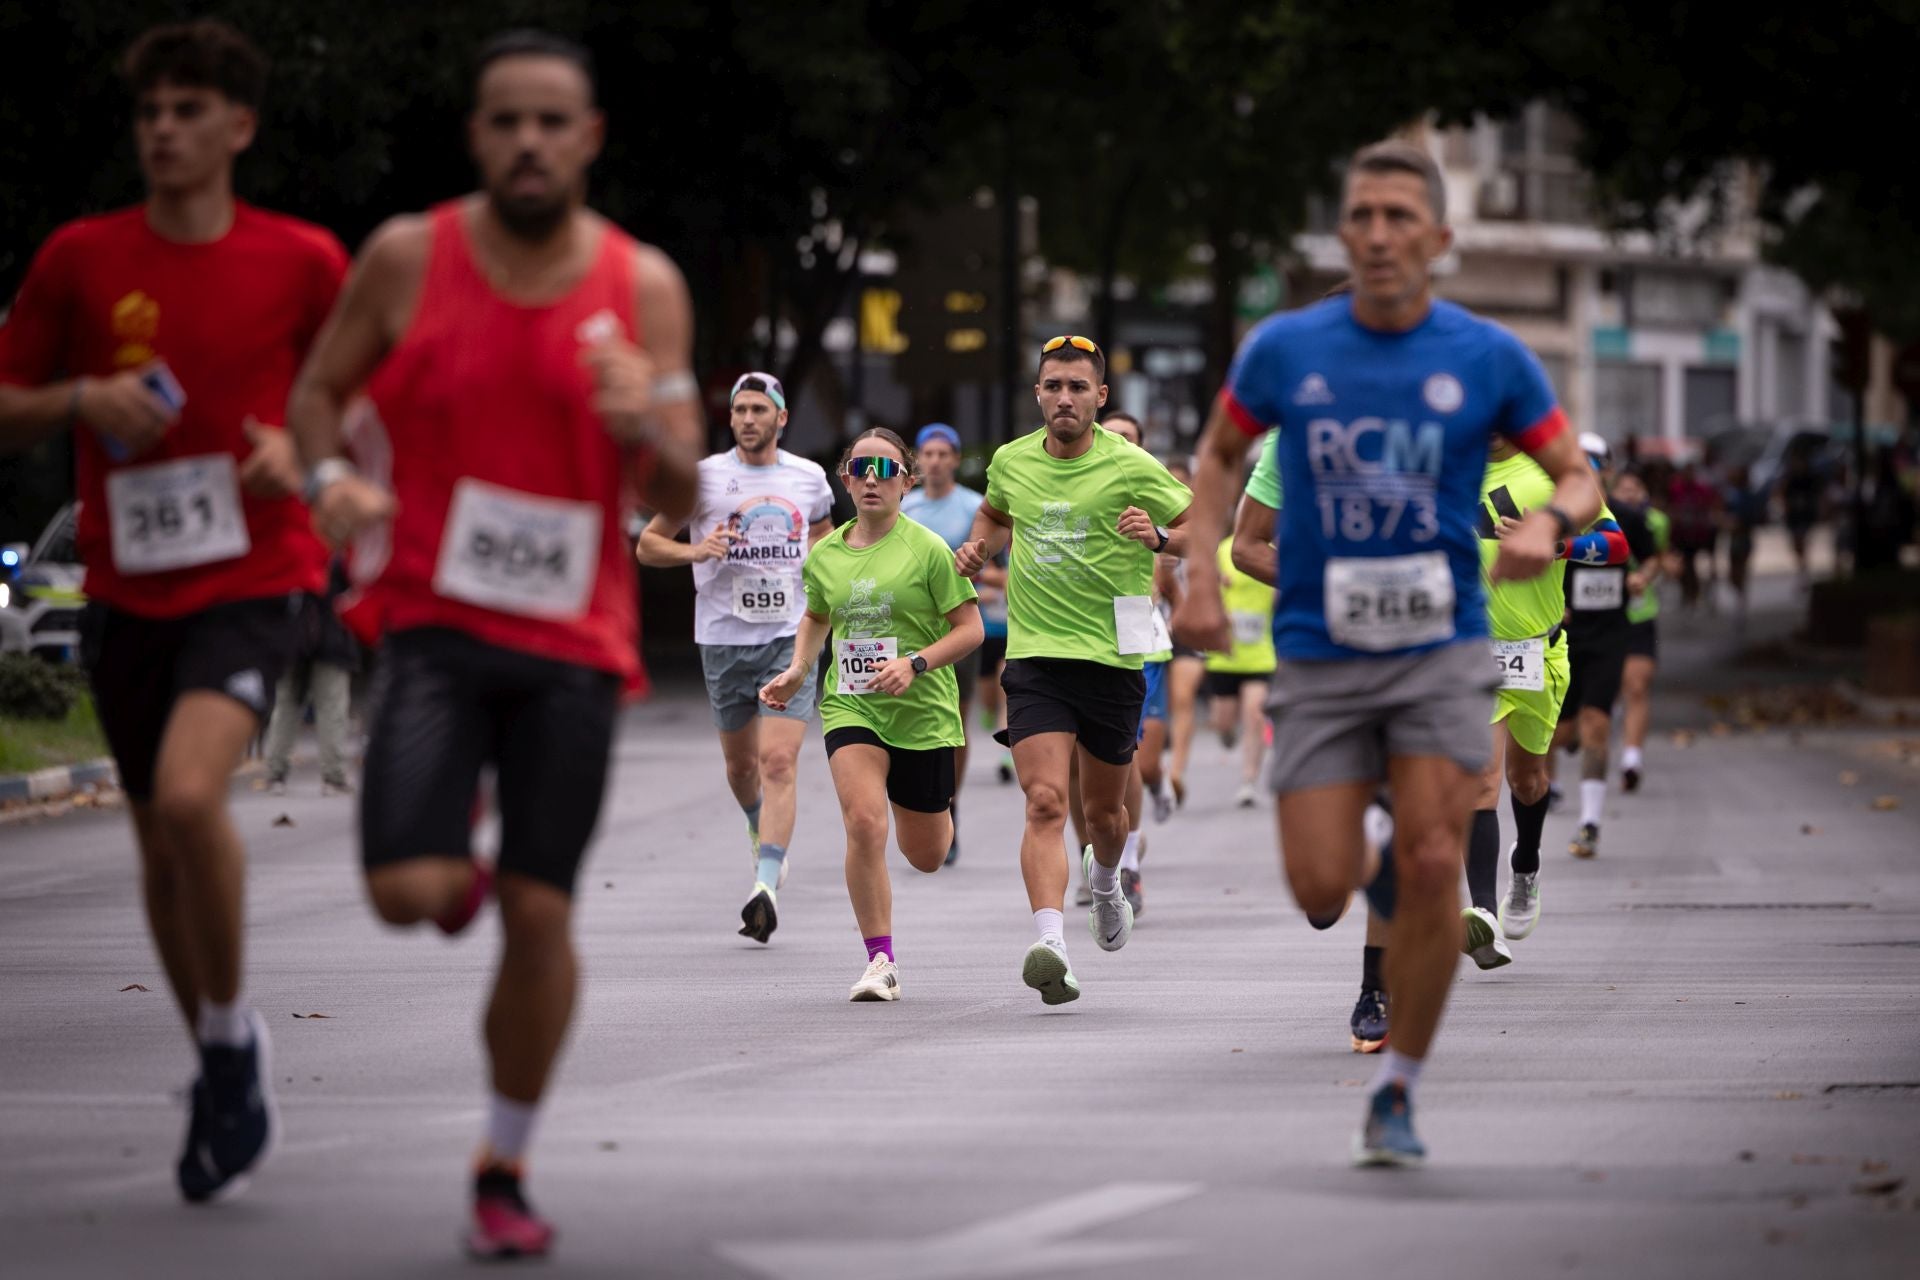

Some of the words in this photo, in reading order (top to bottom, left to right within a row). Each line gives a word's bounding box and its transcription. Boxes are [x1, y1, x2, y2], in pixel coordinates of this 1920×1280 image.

[1307, 416, 1445, 476] RCM
[1316, 493, 1441, 542] 1873
[728, 545, 801, 560] MARBELLA
[742, 591, 785, 608] 699
